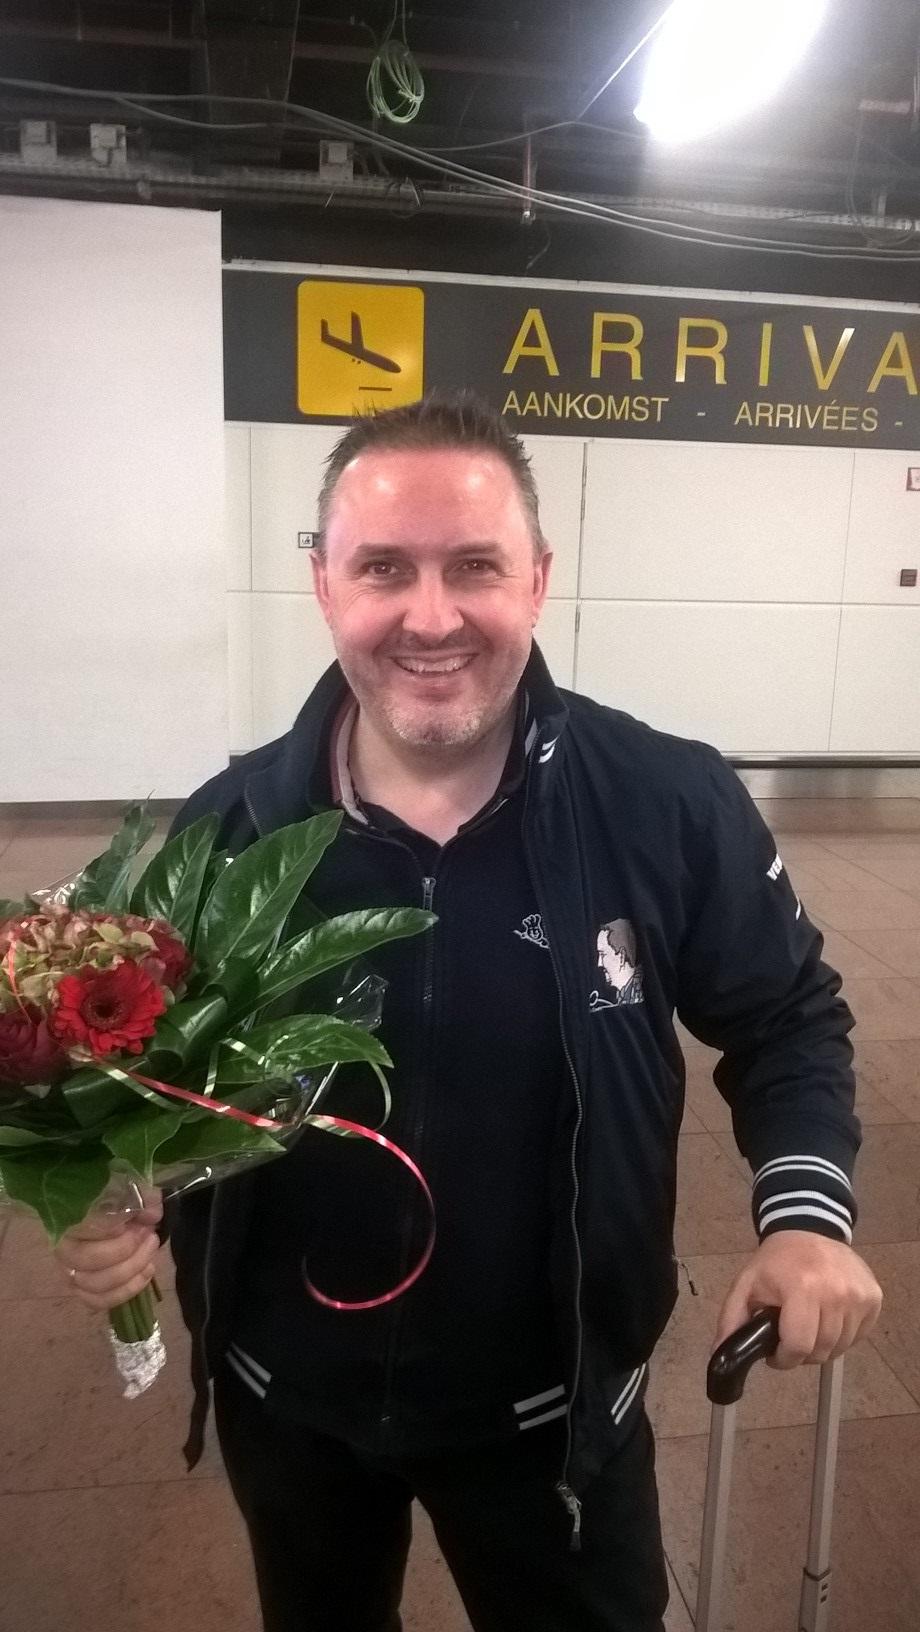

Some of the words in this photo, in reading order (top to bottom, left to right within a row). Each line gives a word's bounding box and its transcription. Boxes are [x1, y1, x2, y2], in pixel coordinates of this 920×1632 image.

[502, 307, 918, 396] ARRIVA
[501, 389, 669, 423] AANKOMST
[734, 400, 879, 432] ARRIVÉES
